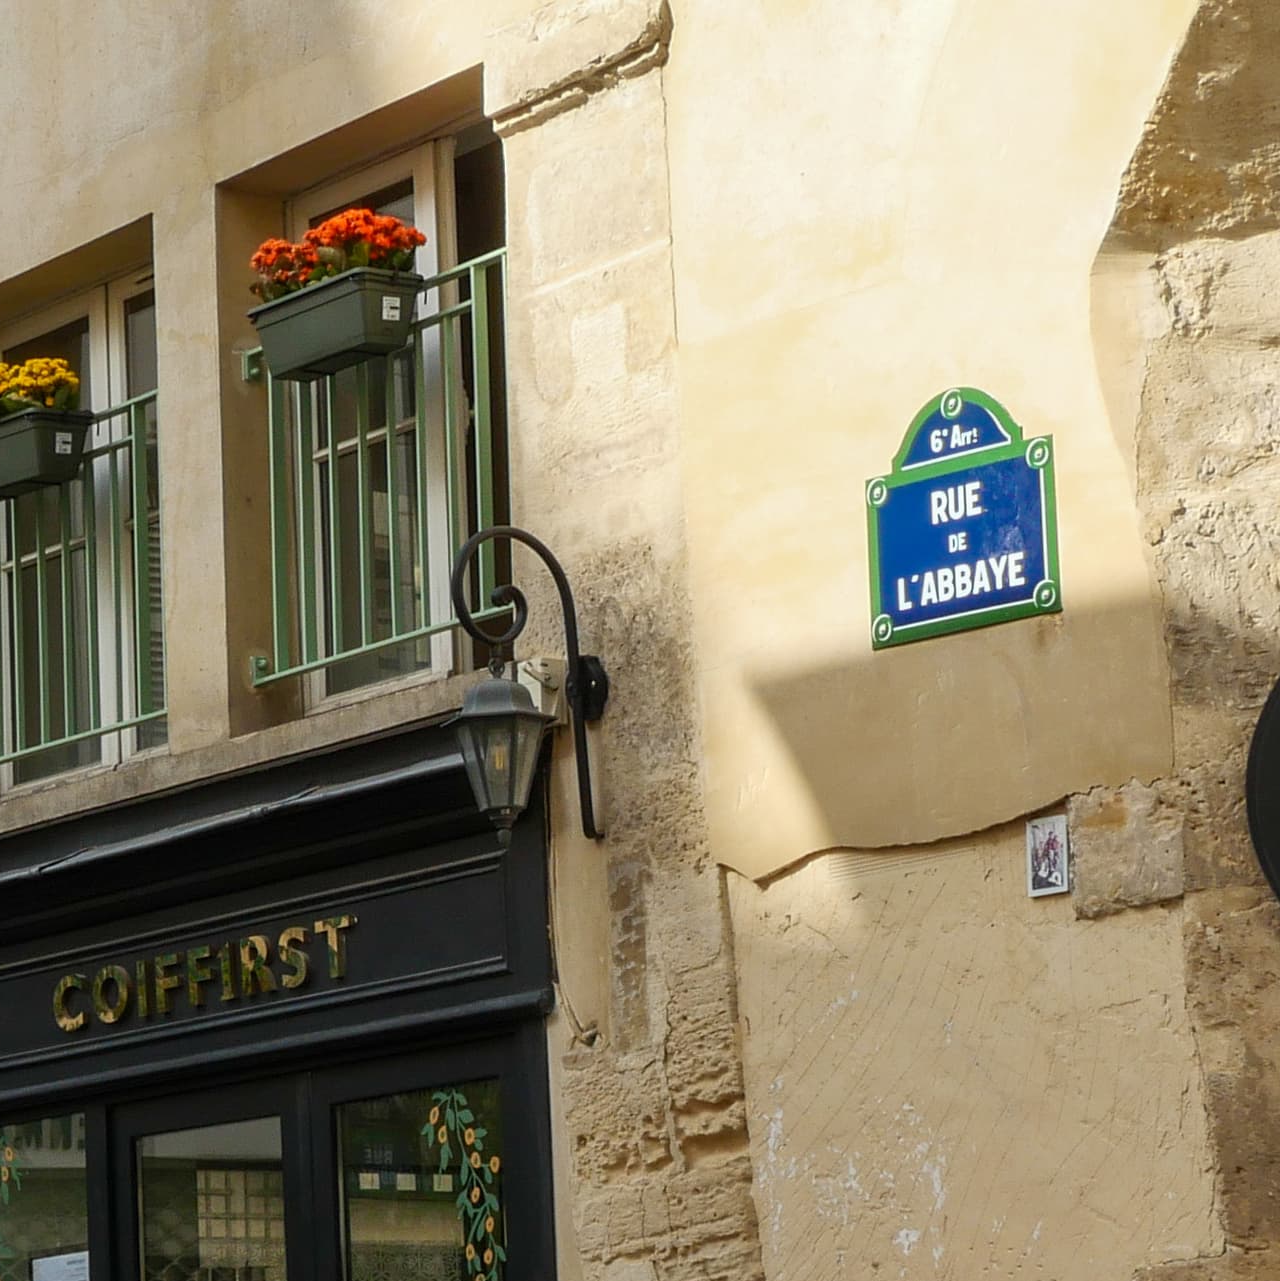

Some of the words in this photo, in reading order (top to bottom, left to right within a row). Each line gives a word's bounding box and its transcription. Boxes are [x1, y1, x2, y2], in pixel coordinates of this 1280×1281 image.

[930, 480, 983, 526] RUE
[948, 532, 968, 553] DE
[897, 551, 1027, 611] L'ABBAYE
